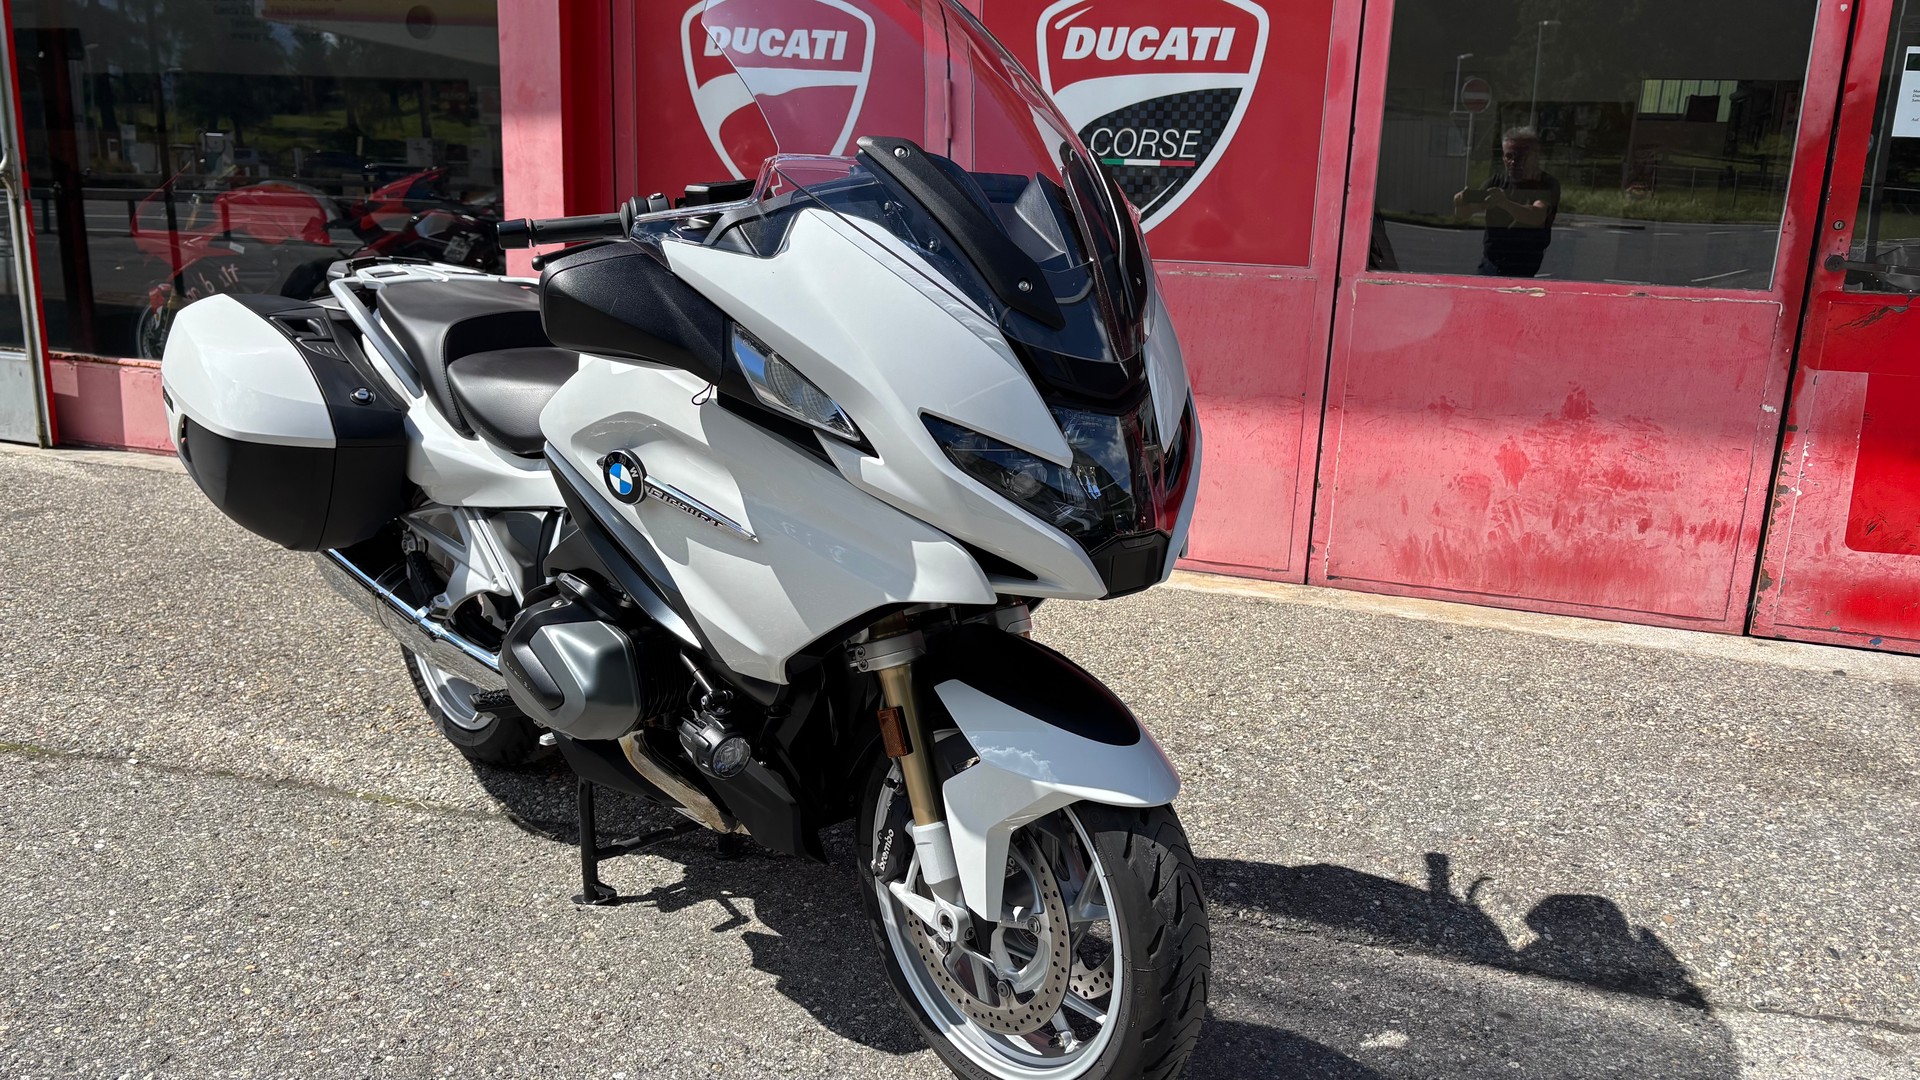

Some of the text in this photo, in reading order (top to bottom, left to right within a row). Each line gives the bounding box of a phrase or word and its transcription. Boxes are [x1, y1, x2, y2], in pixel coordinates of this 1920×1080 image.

[704, 26, 848, 60] DUCATI
[1062, 26, 1236, 61] DUCATI
[1090, 128, 1201, 158] CORSE
[877, 828, 895, 872] brembo
